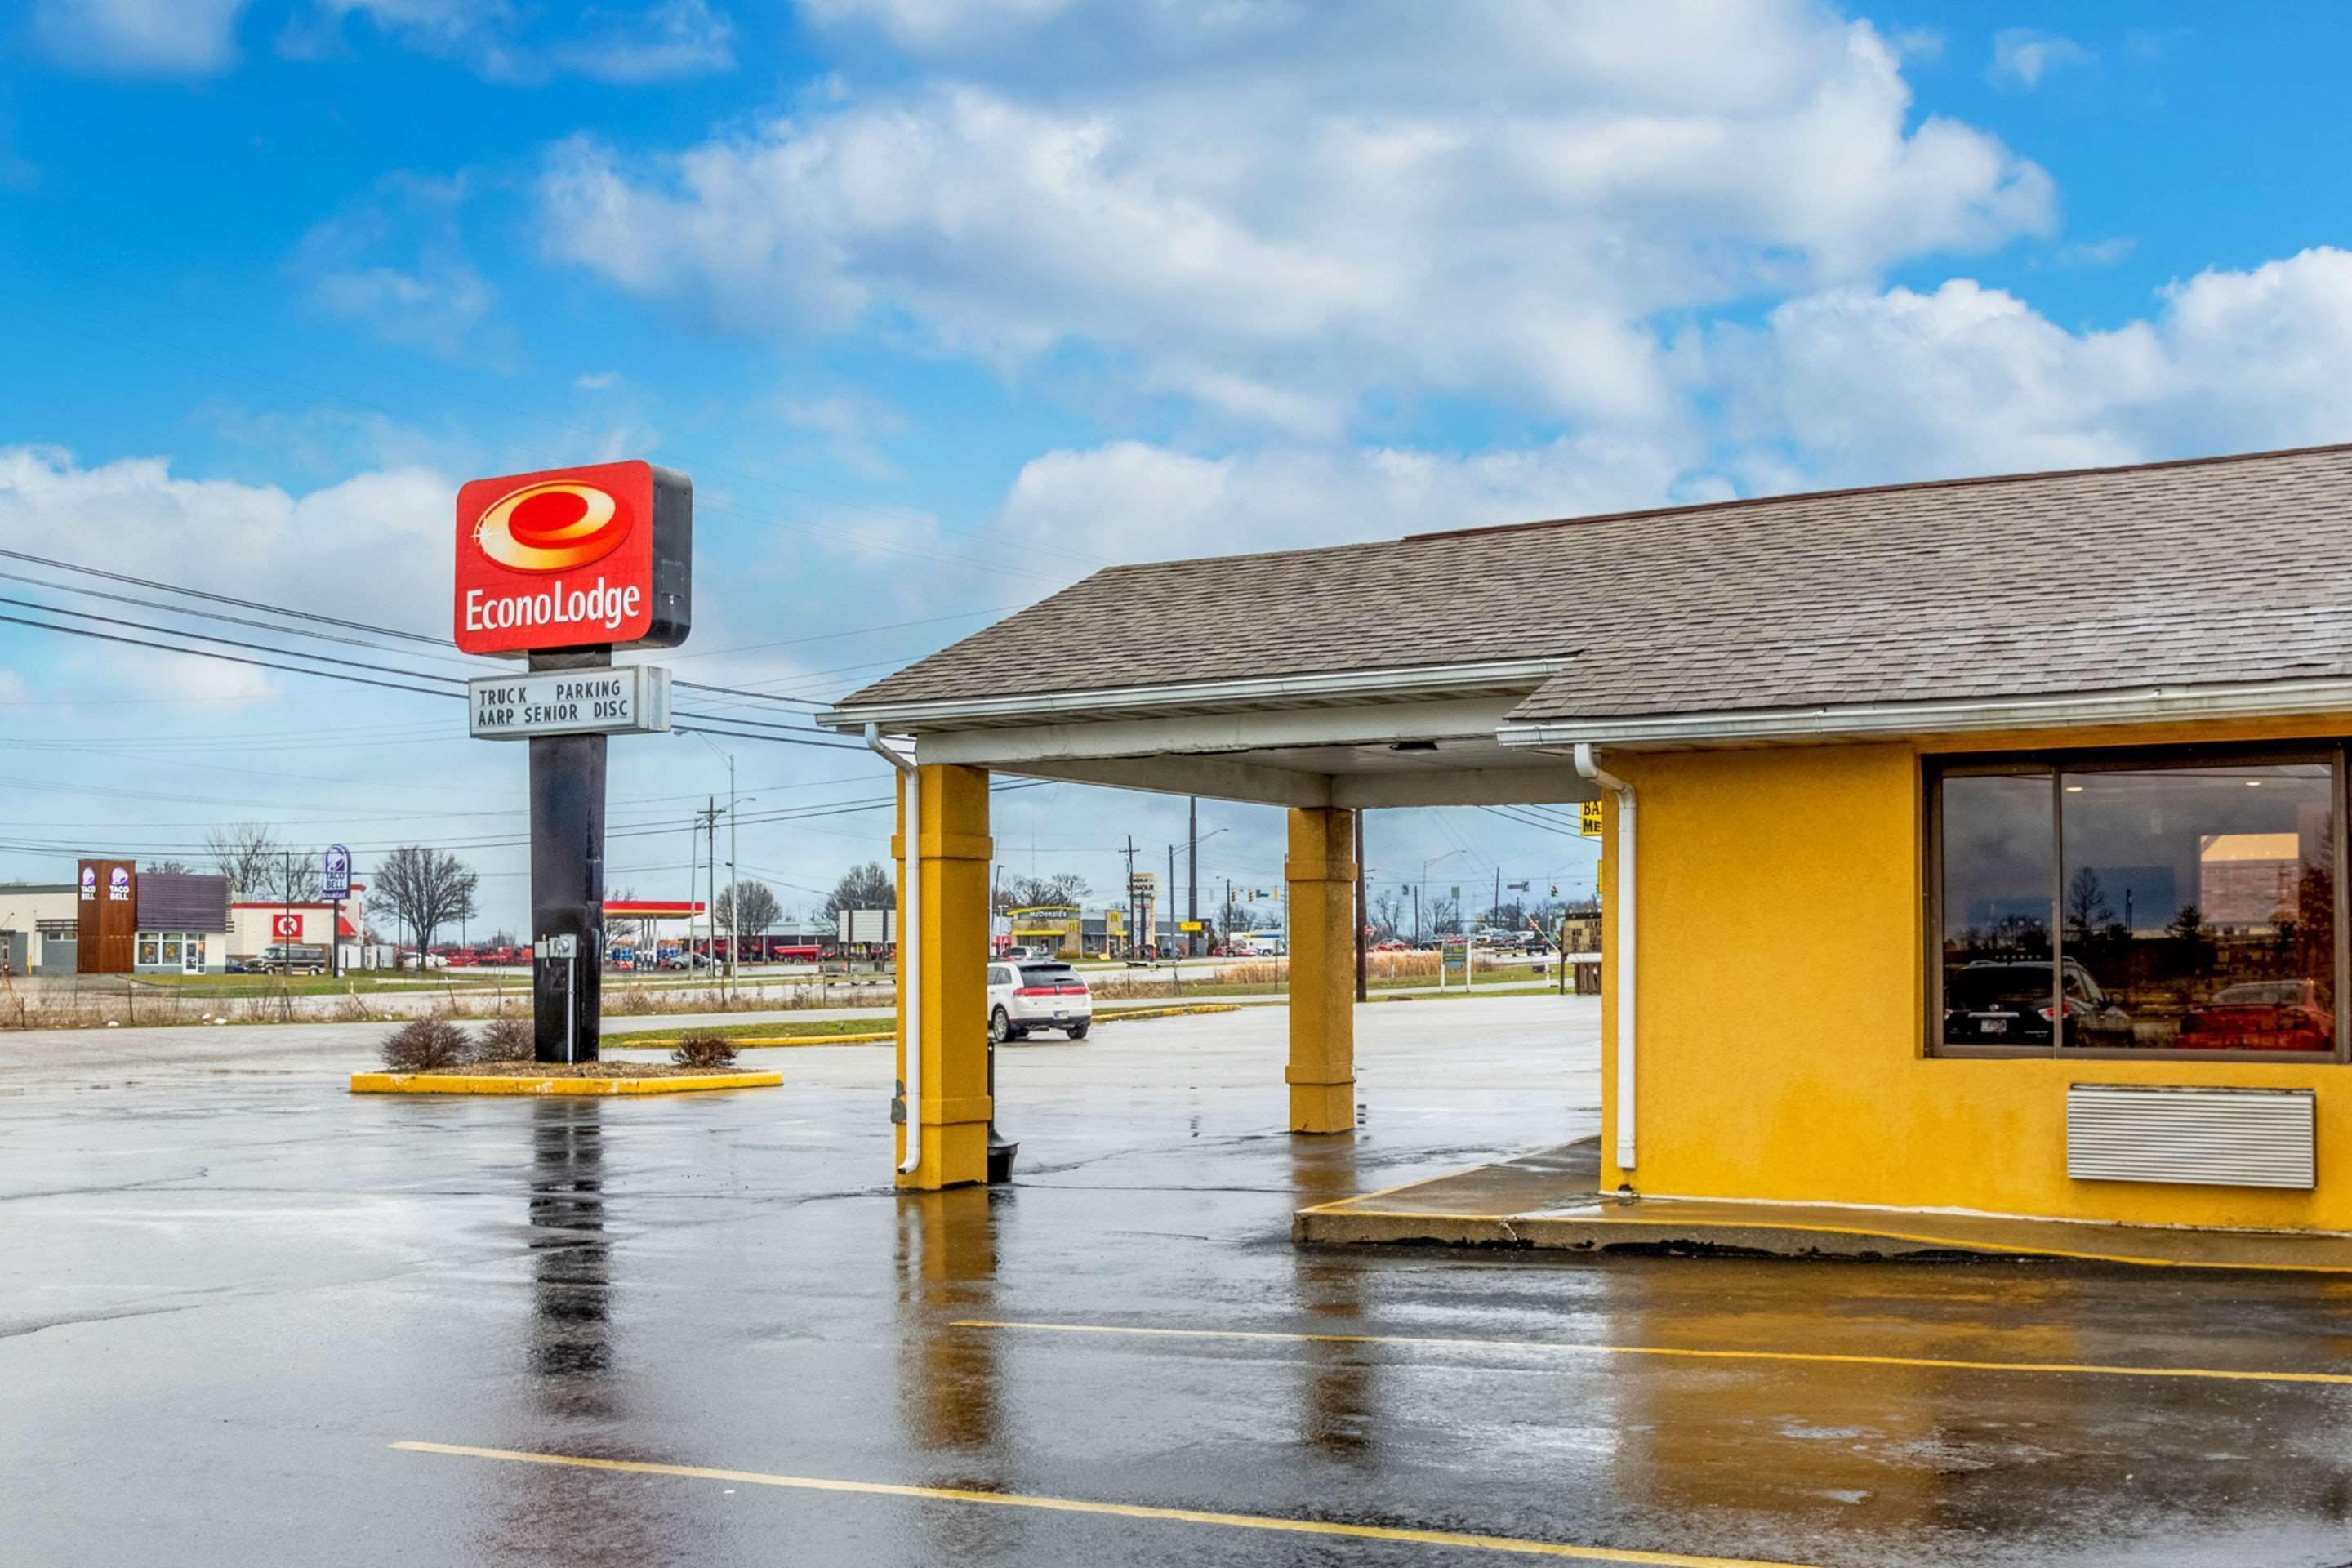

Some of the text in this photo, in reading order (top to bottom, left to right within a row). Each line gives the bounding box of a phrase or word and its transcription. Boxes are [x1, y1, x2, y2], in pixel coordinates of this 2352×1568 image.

[466, 577, 641, 631] EconoLodge
[479, 679, 621, 706] TRUCK PARKING
[478, 699, 628, 726] AARP SENIOR DISC
[109, 885, 130, 893] TACO
[110, 893, 129, 901] BELL
